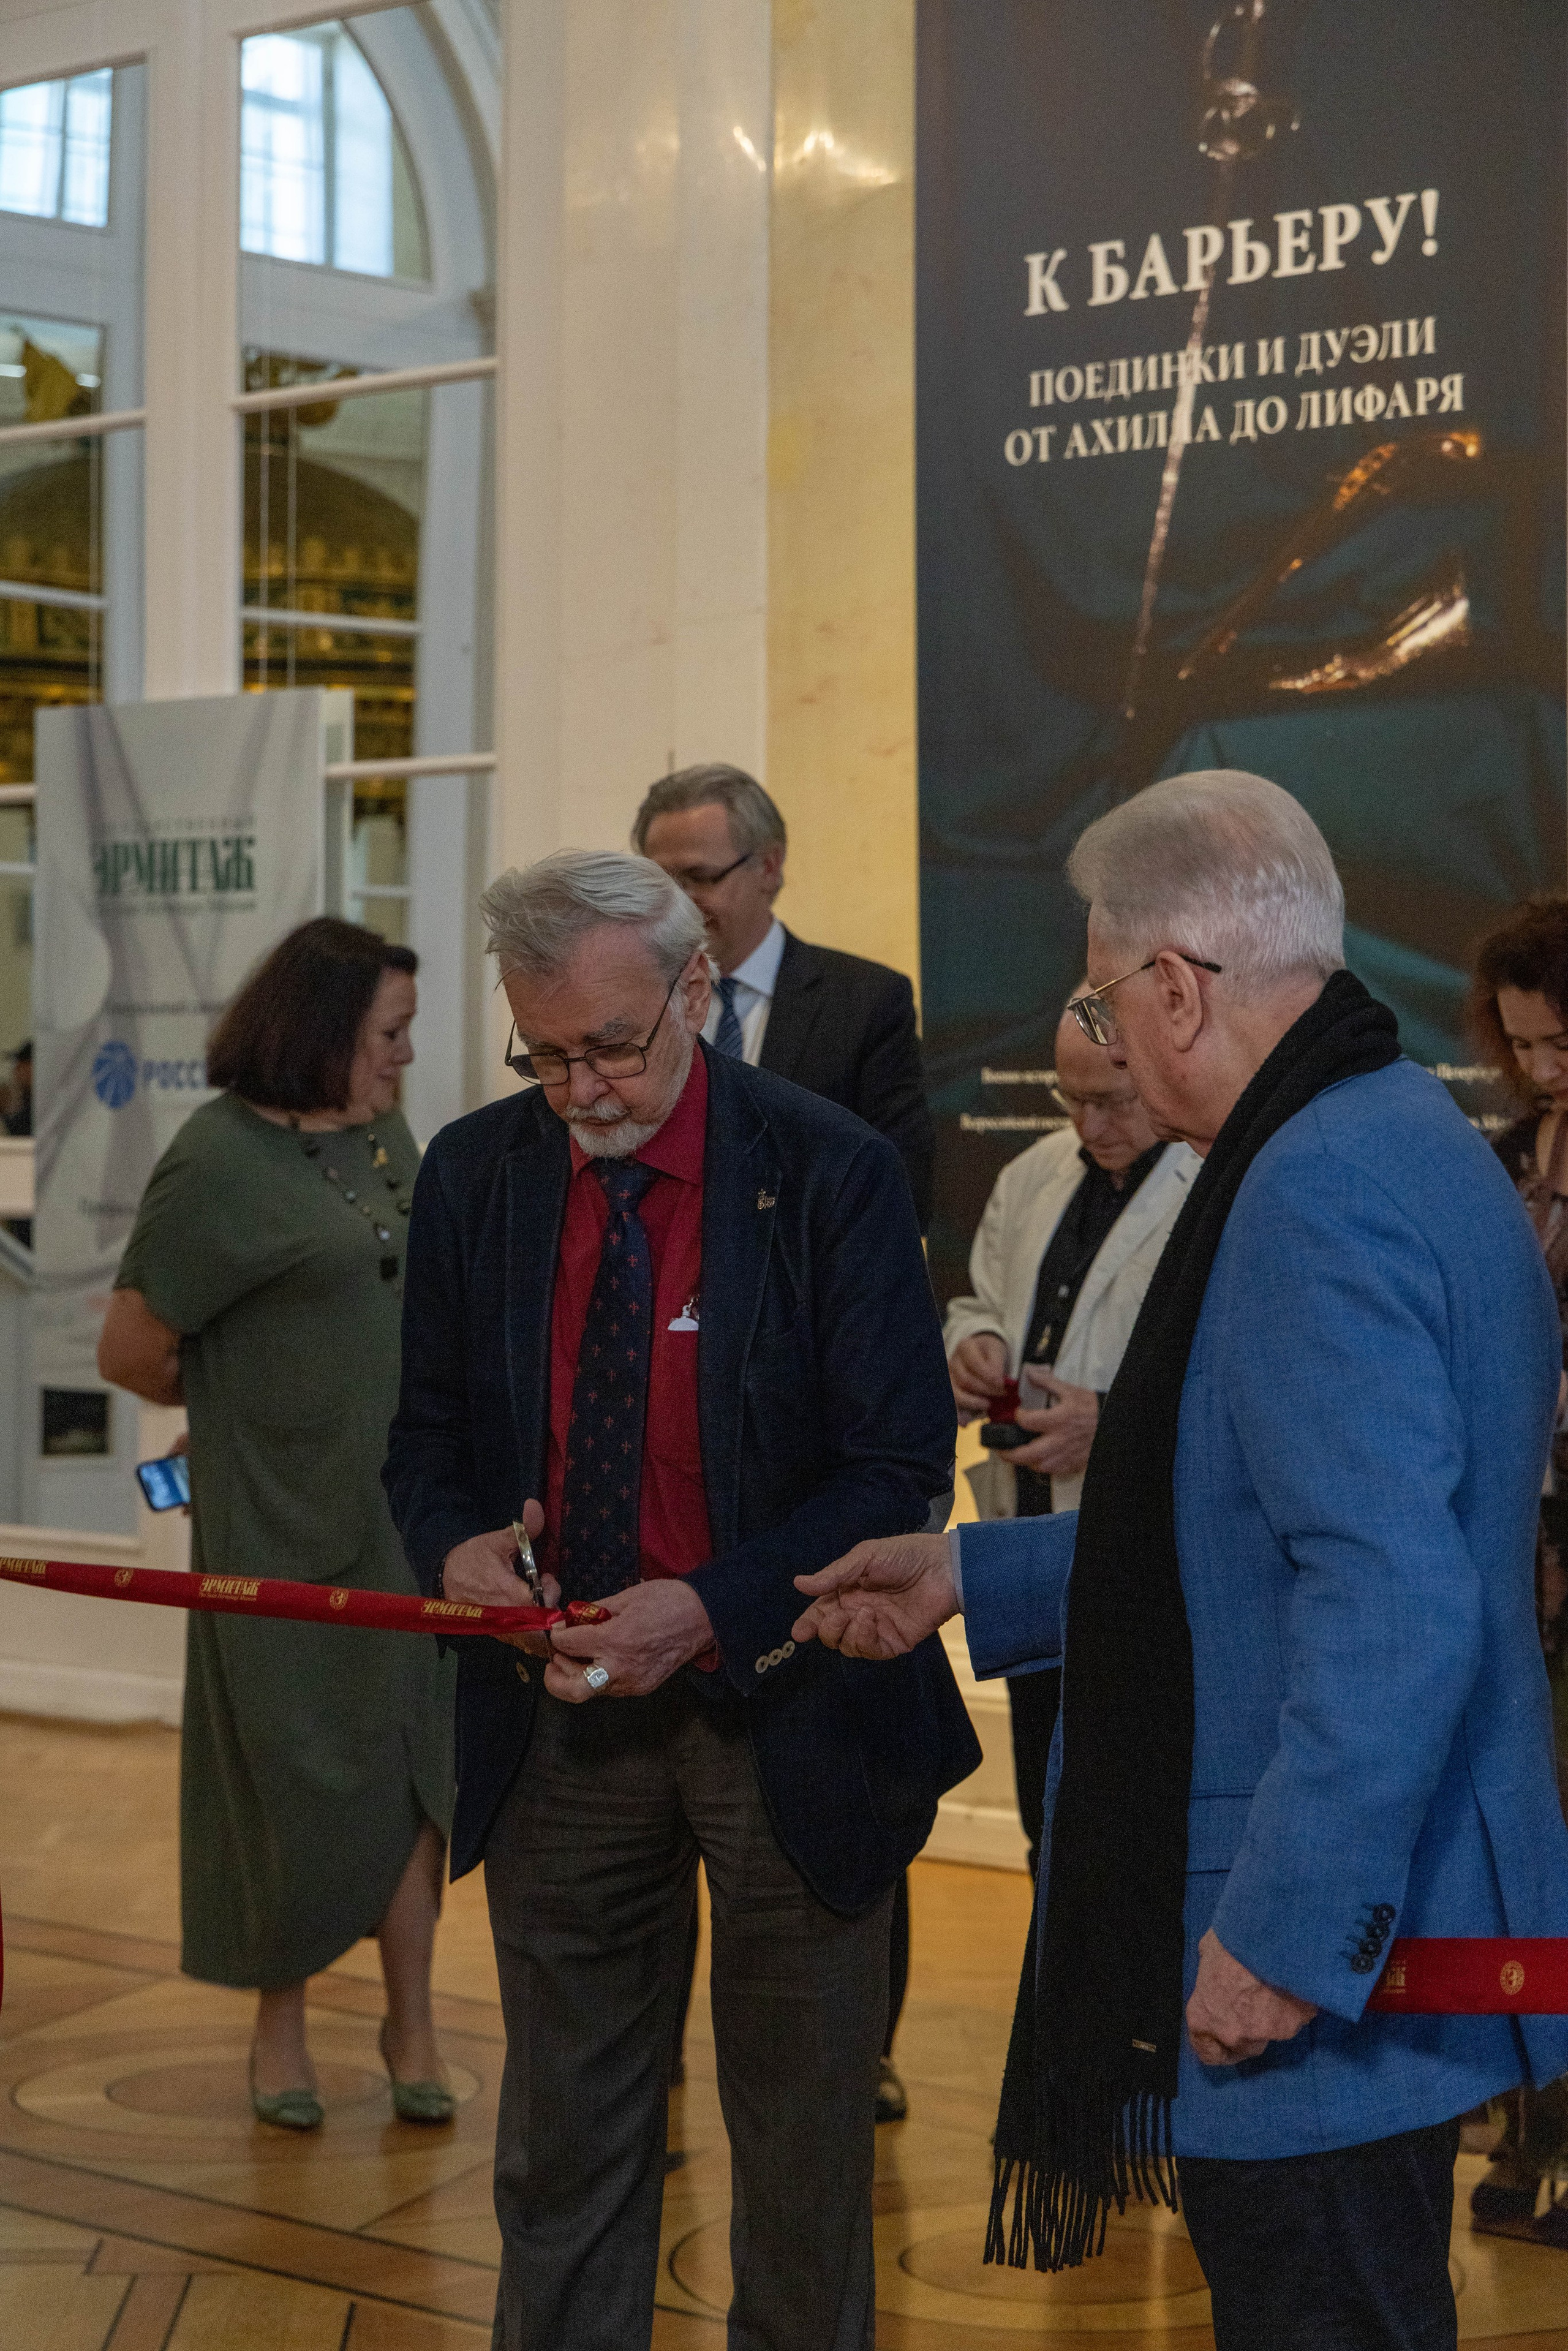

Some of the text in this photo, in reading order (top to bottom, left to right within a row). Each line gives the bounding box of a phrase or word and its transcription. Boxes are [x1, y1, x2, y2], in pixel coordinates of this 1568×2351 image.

[1024, 189, 1439, 316] К БАРЬЕРУ!
[1030, 315, 1436, 407] ПОЕДИНКИ И ДУЭЛИ
[1004, 372, 1464, 466] ОТ АХИЛА ДО ЛИФАРЯ
[0, 1557, 48, 1575] РМИТАЖ
[200, 1578, 260, 1596] ЭРМИТАЖ
[421, 1600, 483, 1618] ЭРМИТАЖ
